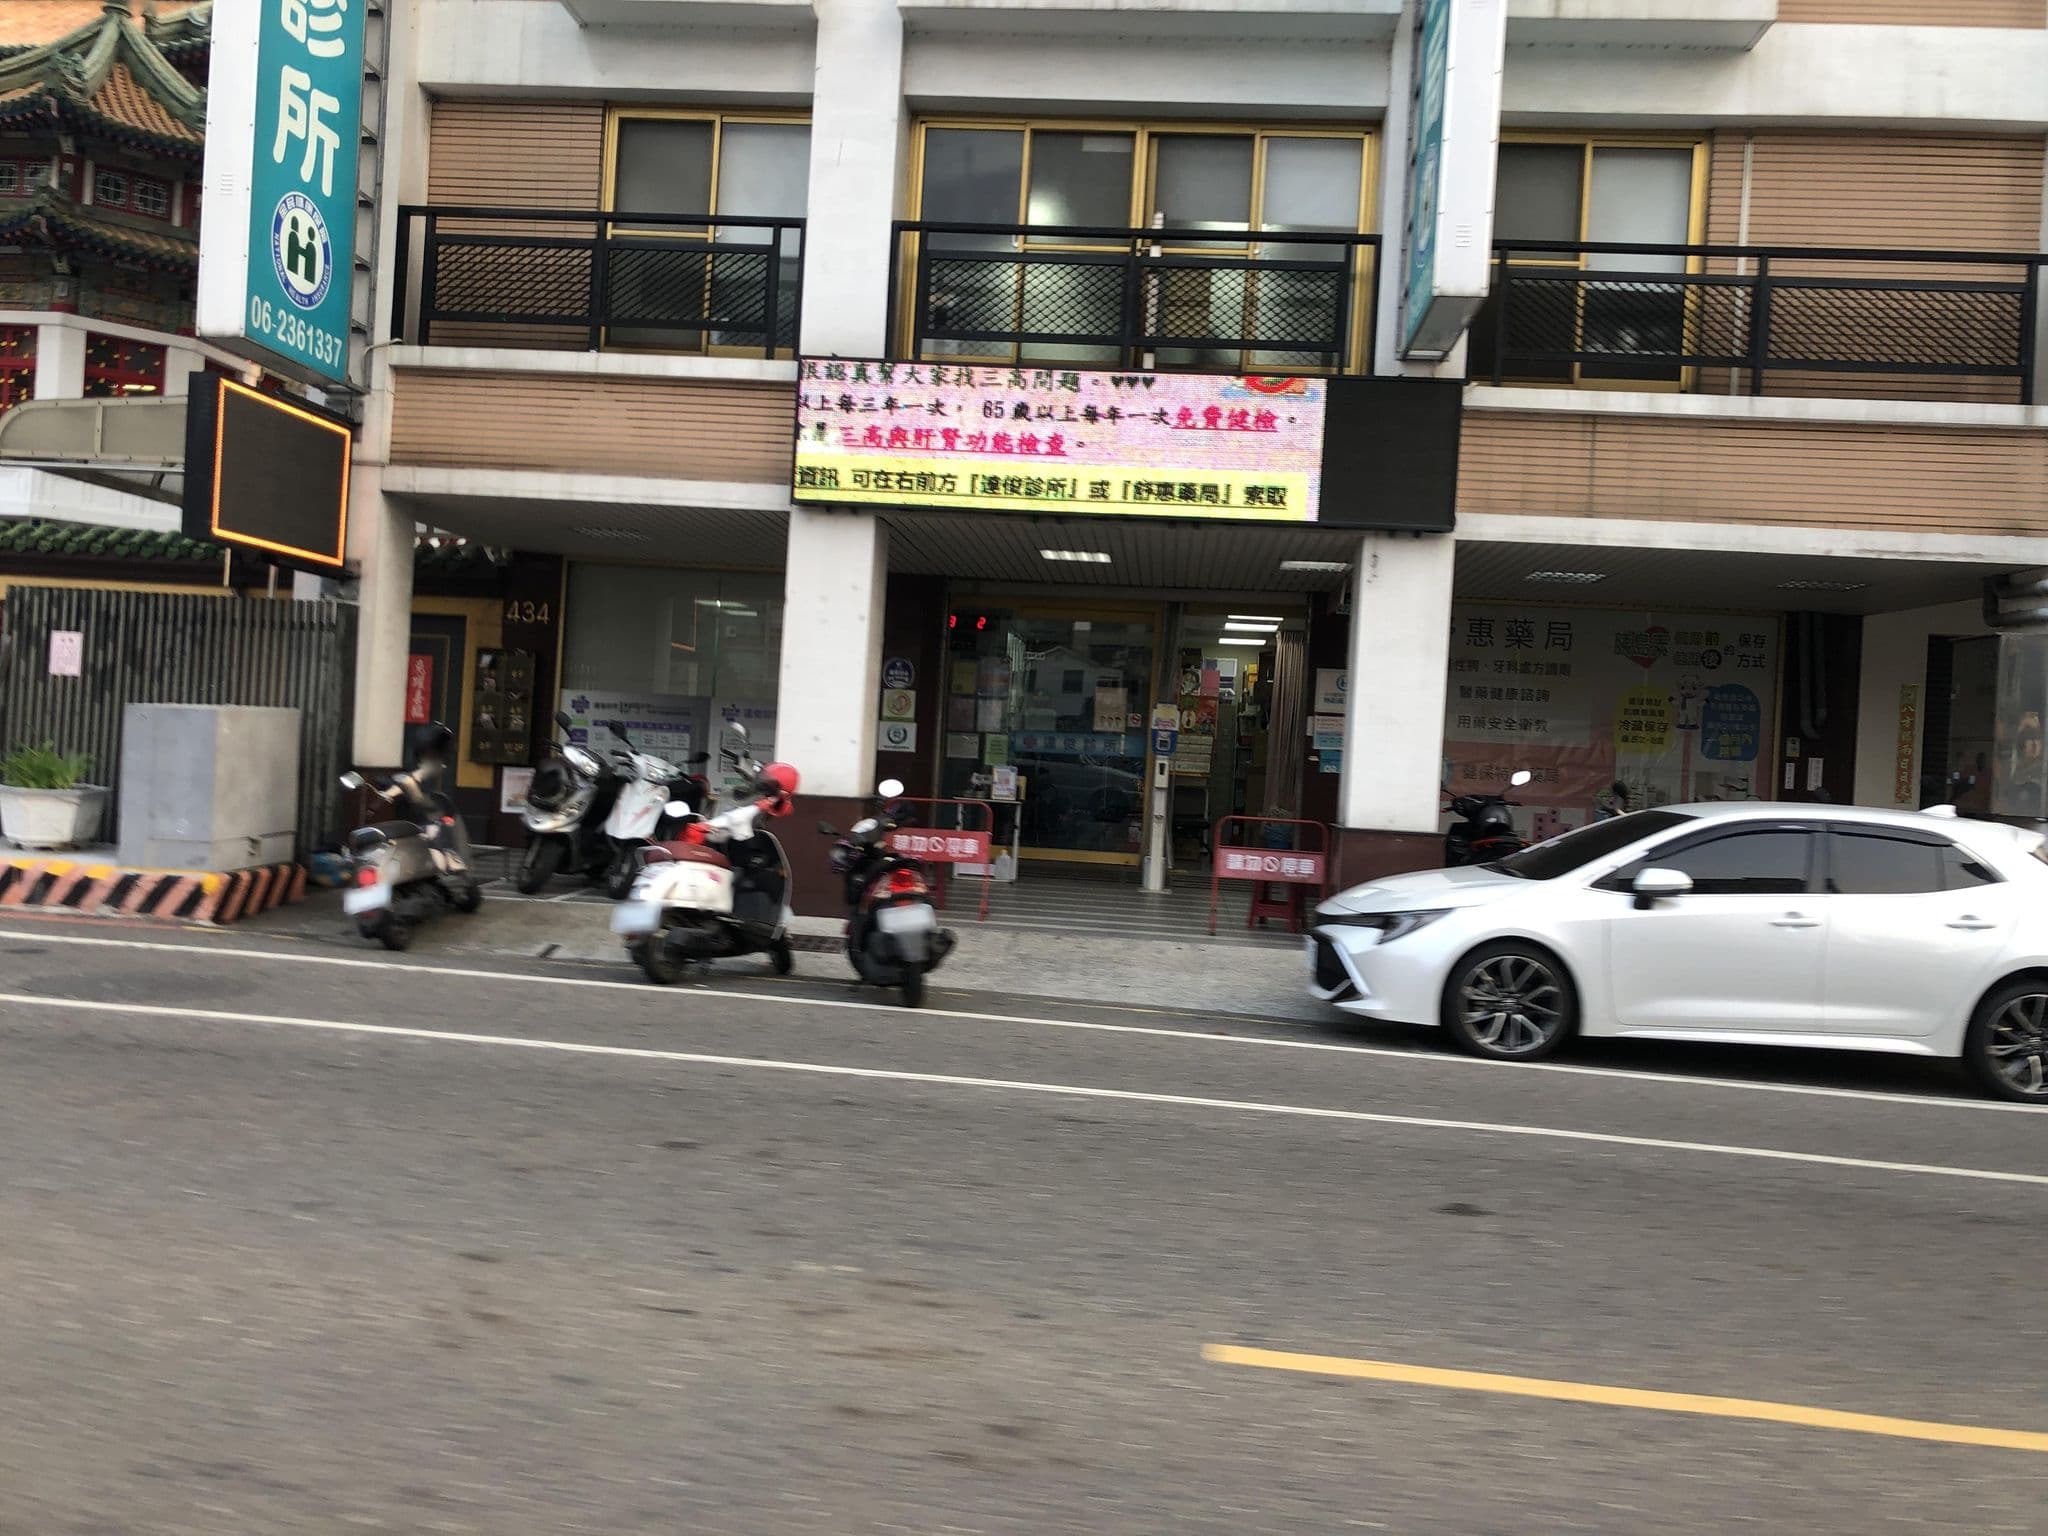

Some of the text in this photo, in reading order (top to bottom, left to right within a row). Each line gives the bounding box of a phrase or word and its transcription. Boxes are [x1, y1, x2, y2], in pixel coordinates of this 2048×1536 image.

[252, 295, 343, 368] 06-2361337
[507, 600, 550, 625] 434
[1451, 616, 1574, 651] 惠藥局
[1738, 633, 1767, 649] 保存
[1737, 654, 1766, 669] 方式
[1459, 685, 1551, 703] 醫藥健康諮詢
[1463, 766, 1560, 784] 健保特藥局
